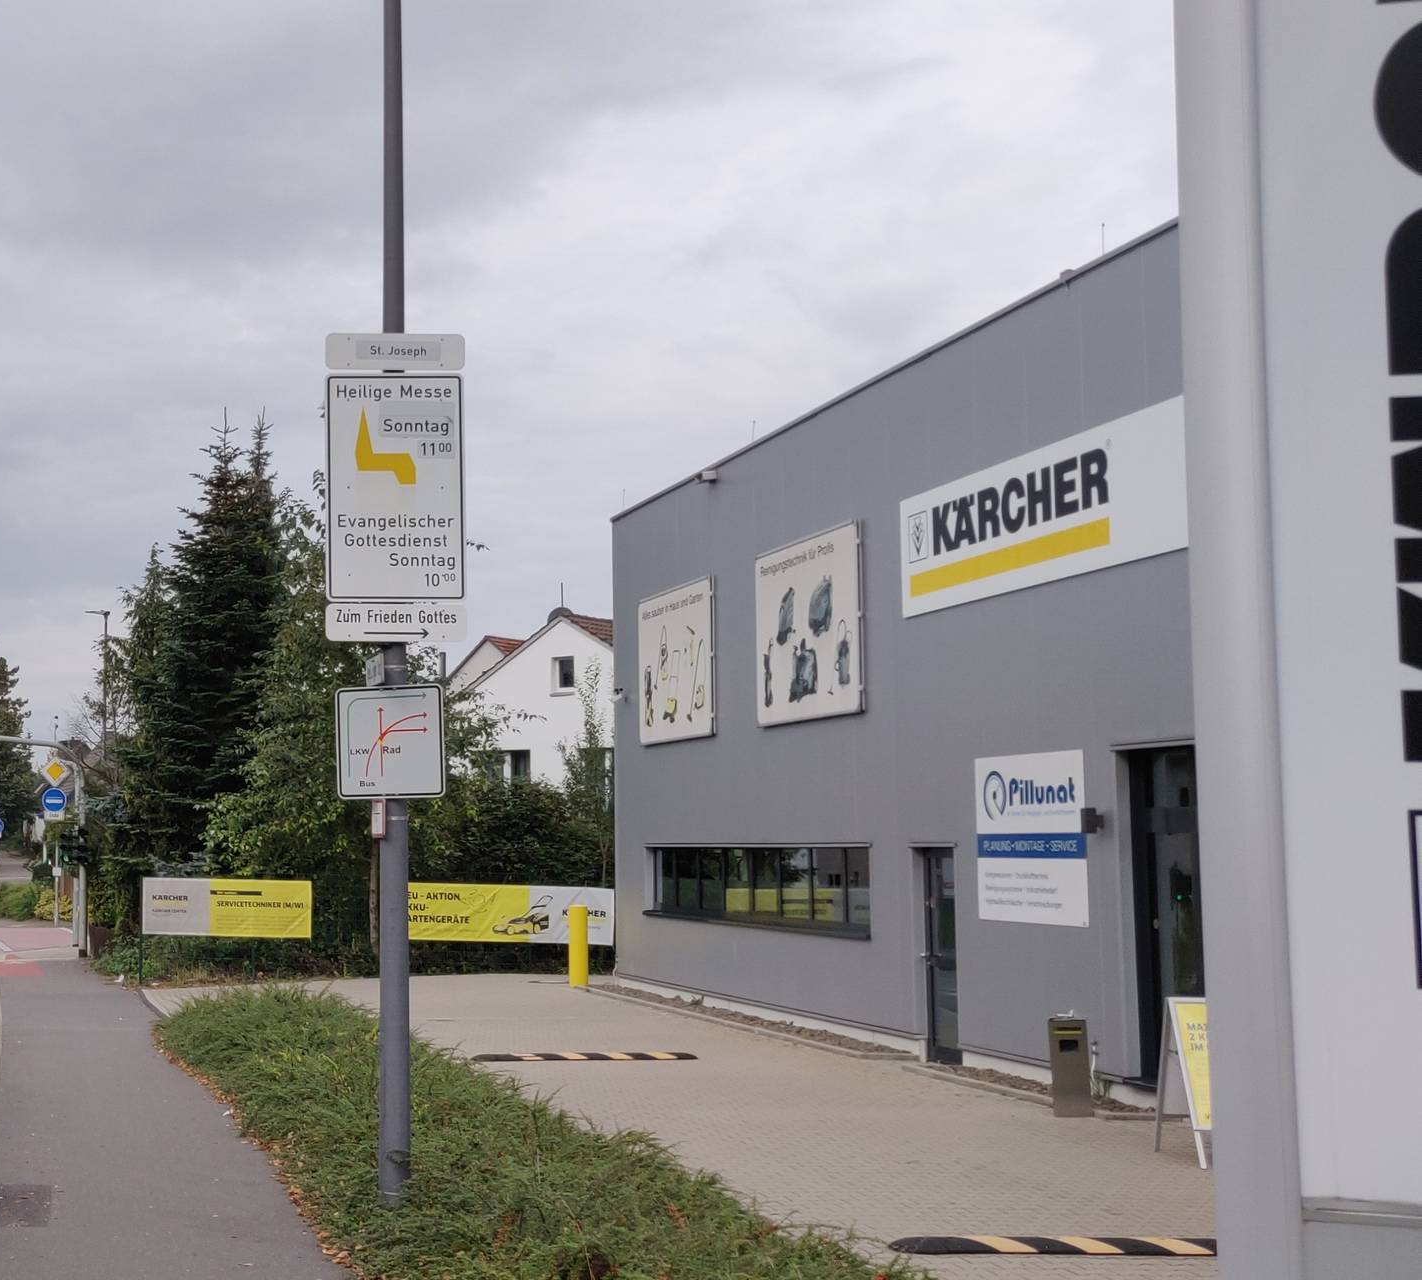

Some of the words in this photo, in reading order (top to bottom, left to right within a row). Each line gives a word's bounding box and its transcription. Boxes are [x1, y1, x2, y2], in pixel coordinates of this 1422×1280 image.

[370, 345, 384, 356] St.
[388, 345, 427, 358] Joseph
[336, 384, 392, 402] Heilige
[400, 384, 452, 399] Messe
[383, 418, 450, 436] Sonntag
[932, 448, 1110, 557] KÄRCHER
[337, 514, 455, 531] Evangelischer
[344, 533, 448, 548] Gottesdienst
[389, 552, 456, 570] Sonntag
[336, 608, 361, 623] Zum
[367, 609, 412, 623] Frieden
[419, 609, 457, 624] Gottes
[383, 745, 401, 754] Rad
[1009, 776, 1076, 806] Pillunat
[983, 840, 1011, 851] PLANUNG
[1014, 840, 1045, 852] MONTAGE
[1049, 840, 1078, 852] SERVICE
[407, 892, 418, 900] EU
[426, 892, 461, 901] AKTION
[217, 900, 282, 909] SERVICETECHNIKER
[408, 903, 429, 911] KKU-
[407, 914, 471, 924] ARTENGERÄTE
